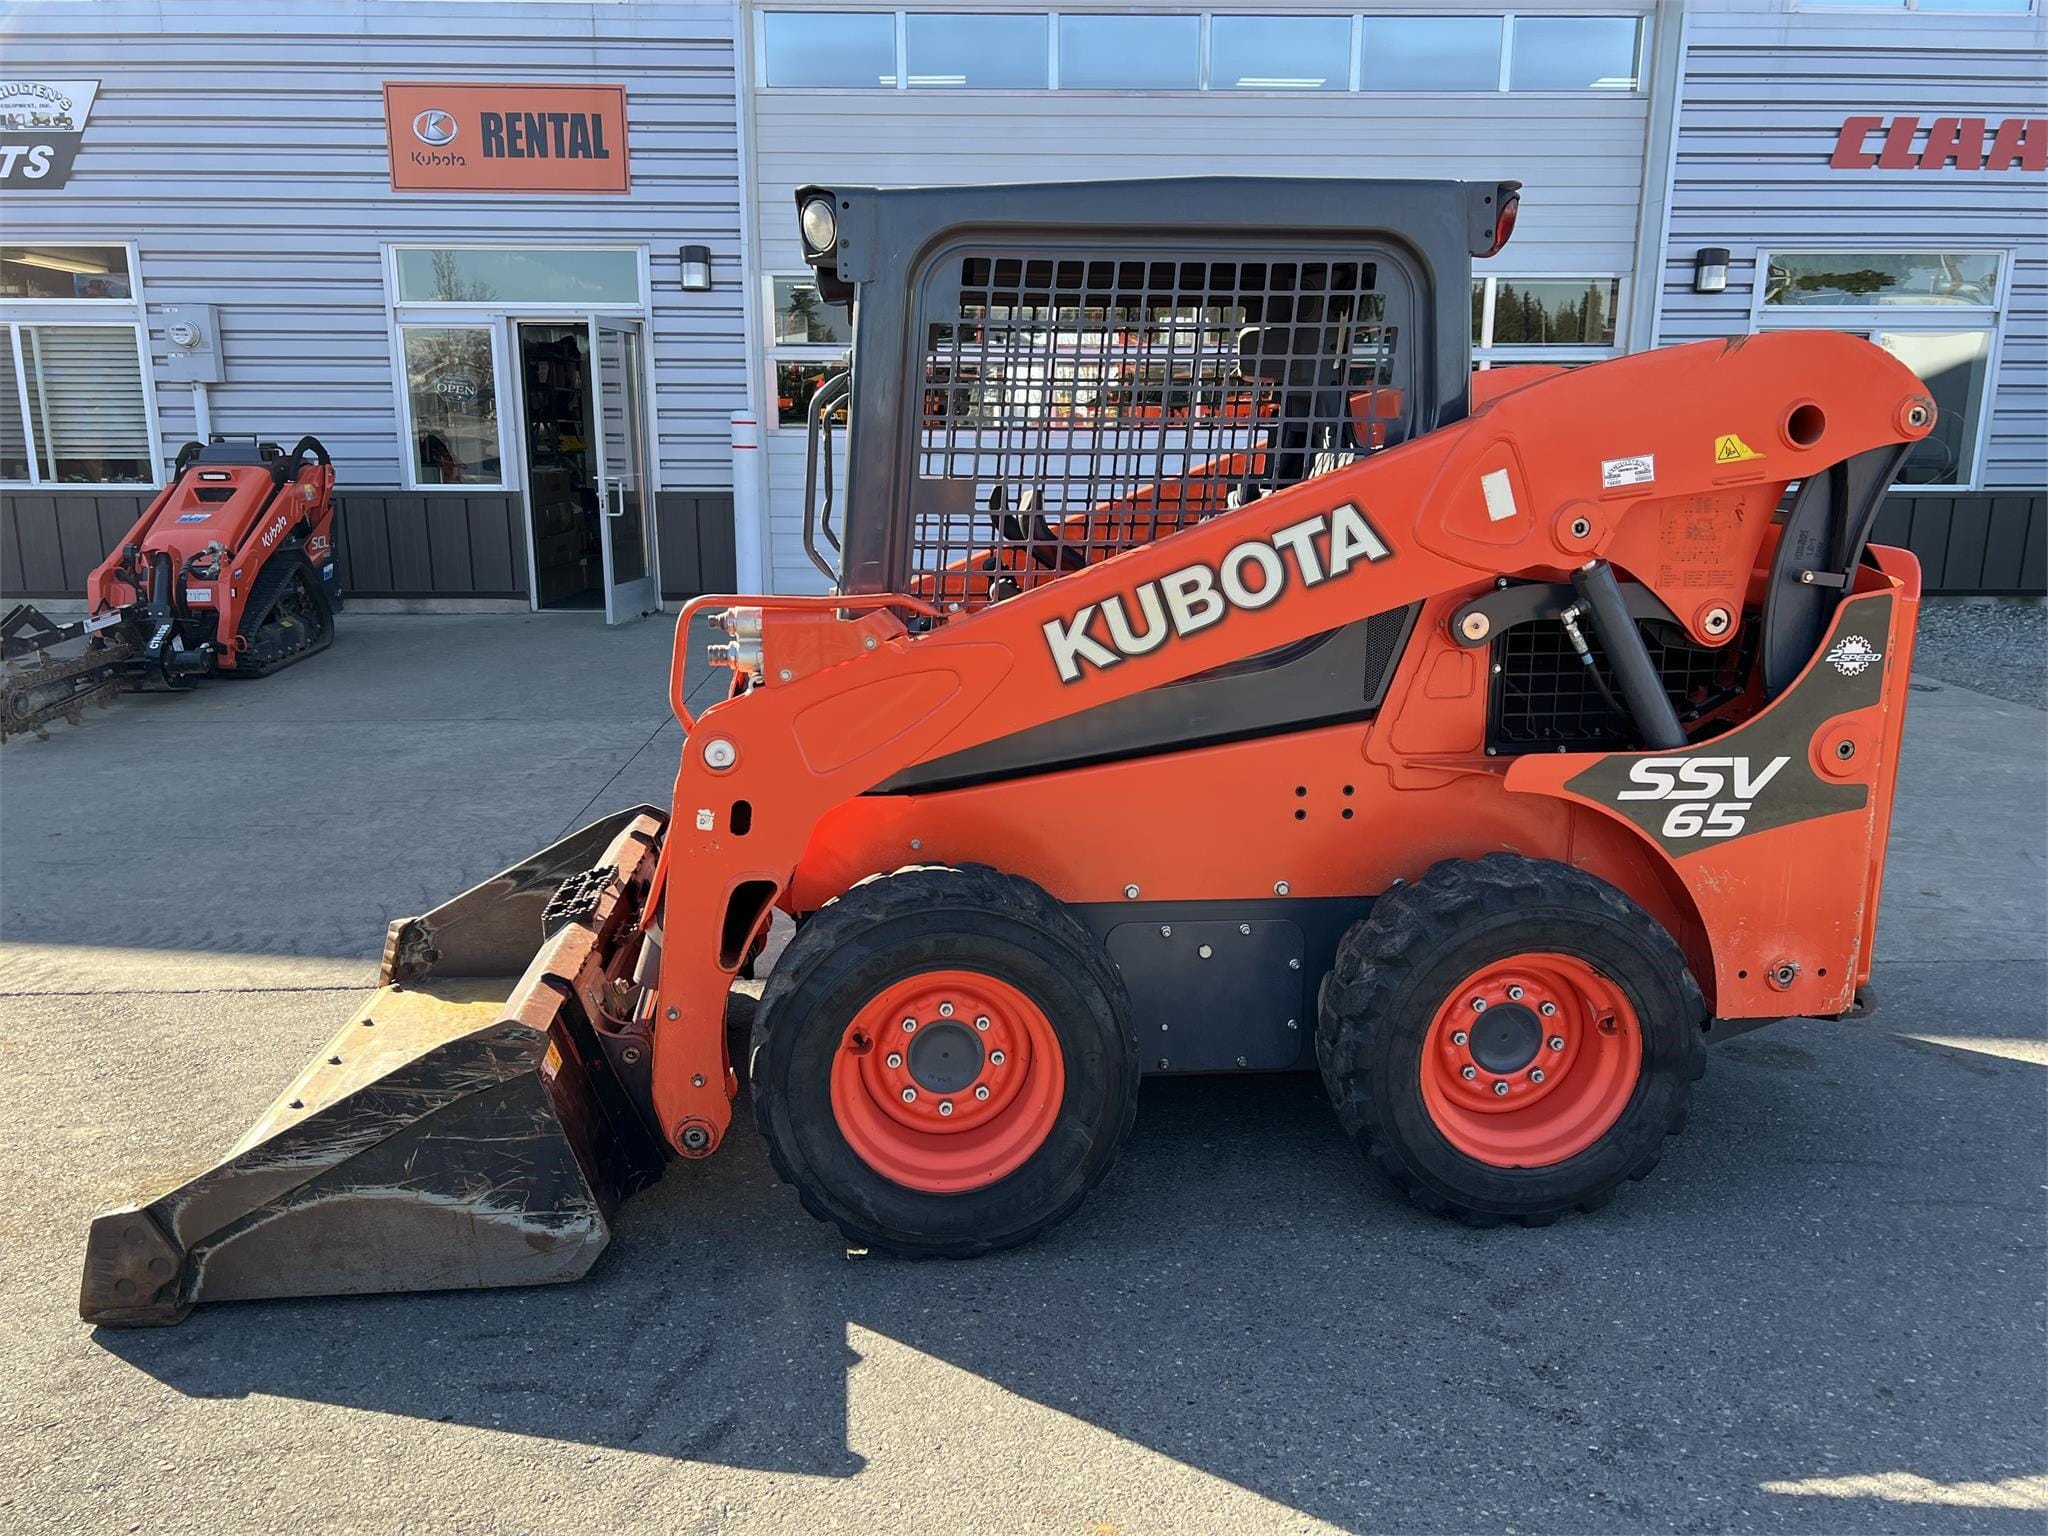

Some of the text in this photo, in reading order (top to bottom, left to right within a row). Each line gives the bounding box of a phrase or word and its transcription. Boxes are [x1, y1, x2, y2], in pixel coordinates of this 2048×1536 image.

[480, 112, 609, 159] RENTAL
[411, 151, 466, 166] Kubota
[437, 383, 475, 395] OPEN
[262, 516, 287, 547] Kubota
[1042, 503, 1391, 683] KUBOTA
[1617, 756, 1792, 800] SSV
[1662, 802, 1752, 837] 65
